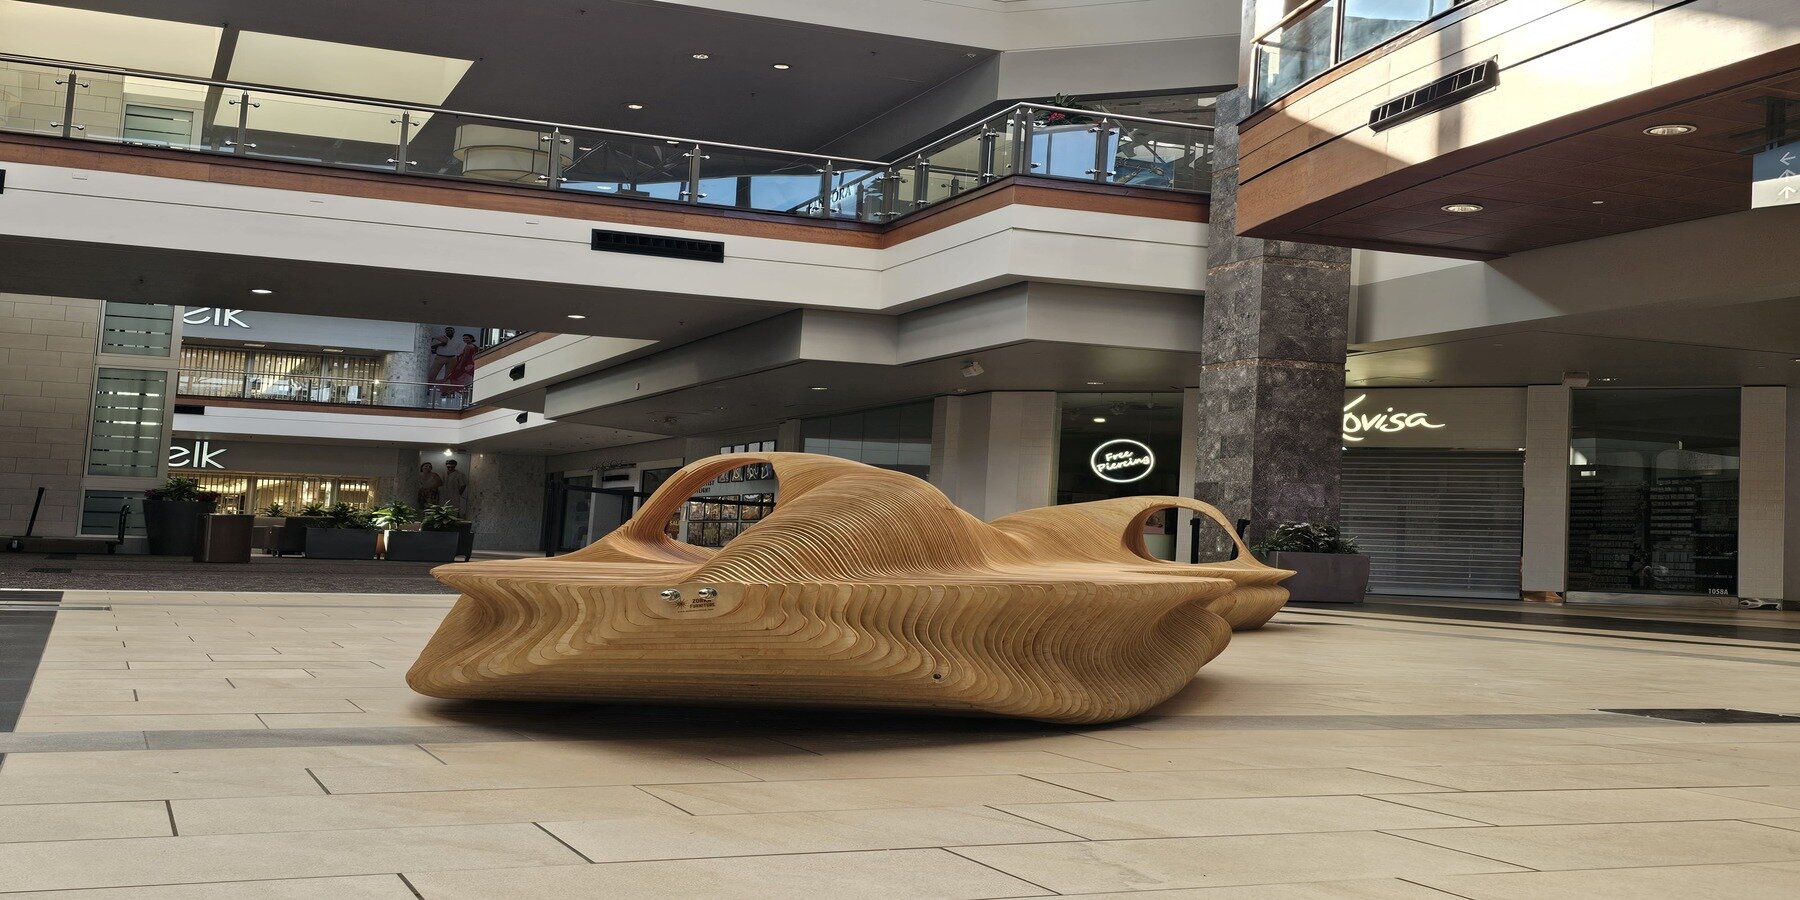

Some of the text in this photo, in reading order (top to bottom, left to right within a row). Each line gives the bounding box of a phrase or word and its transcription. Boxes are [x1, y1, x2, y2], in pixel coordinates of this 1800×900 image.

[168, 441, 228, 469] elk
[1096, 455, 1151, 473] Piercing
[1105, 450, 1134, 462] Free
